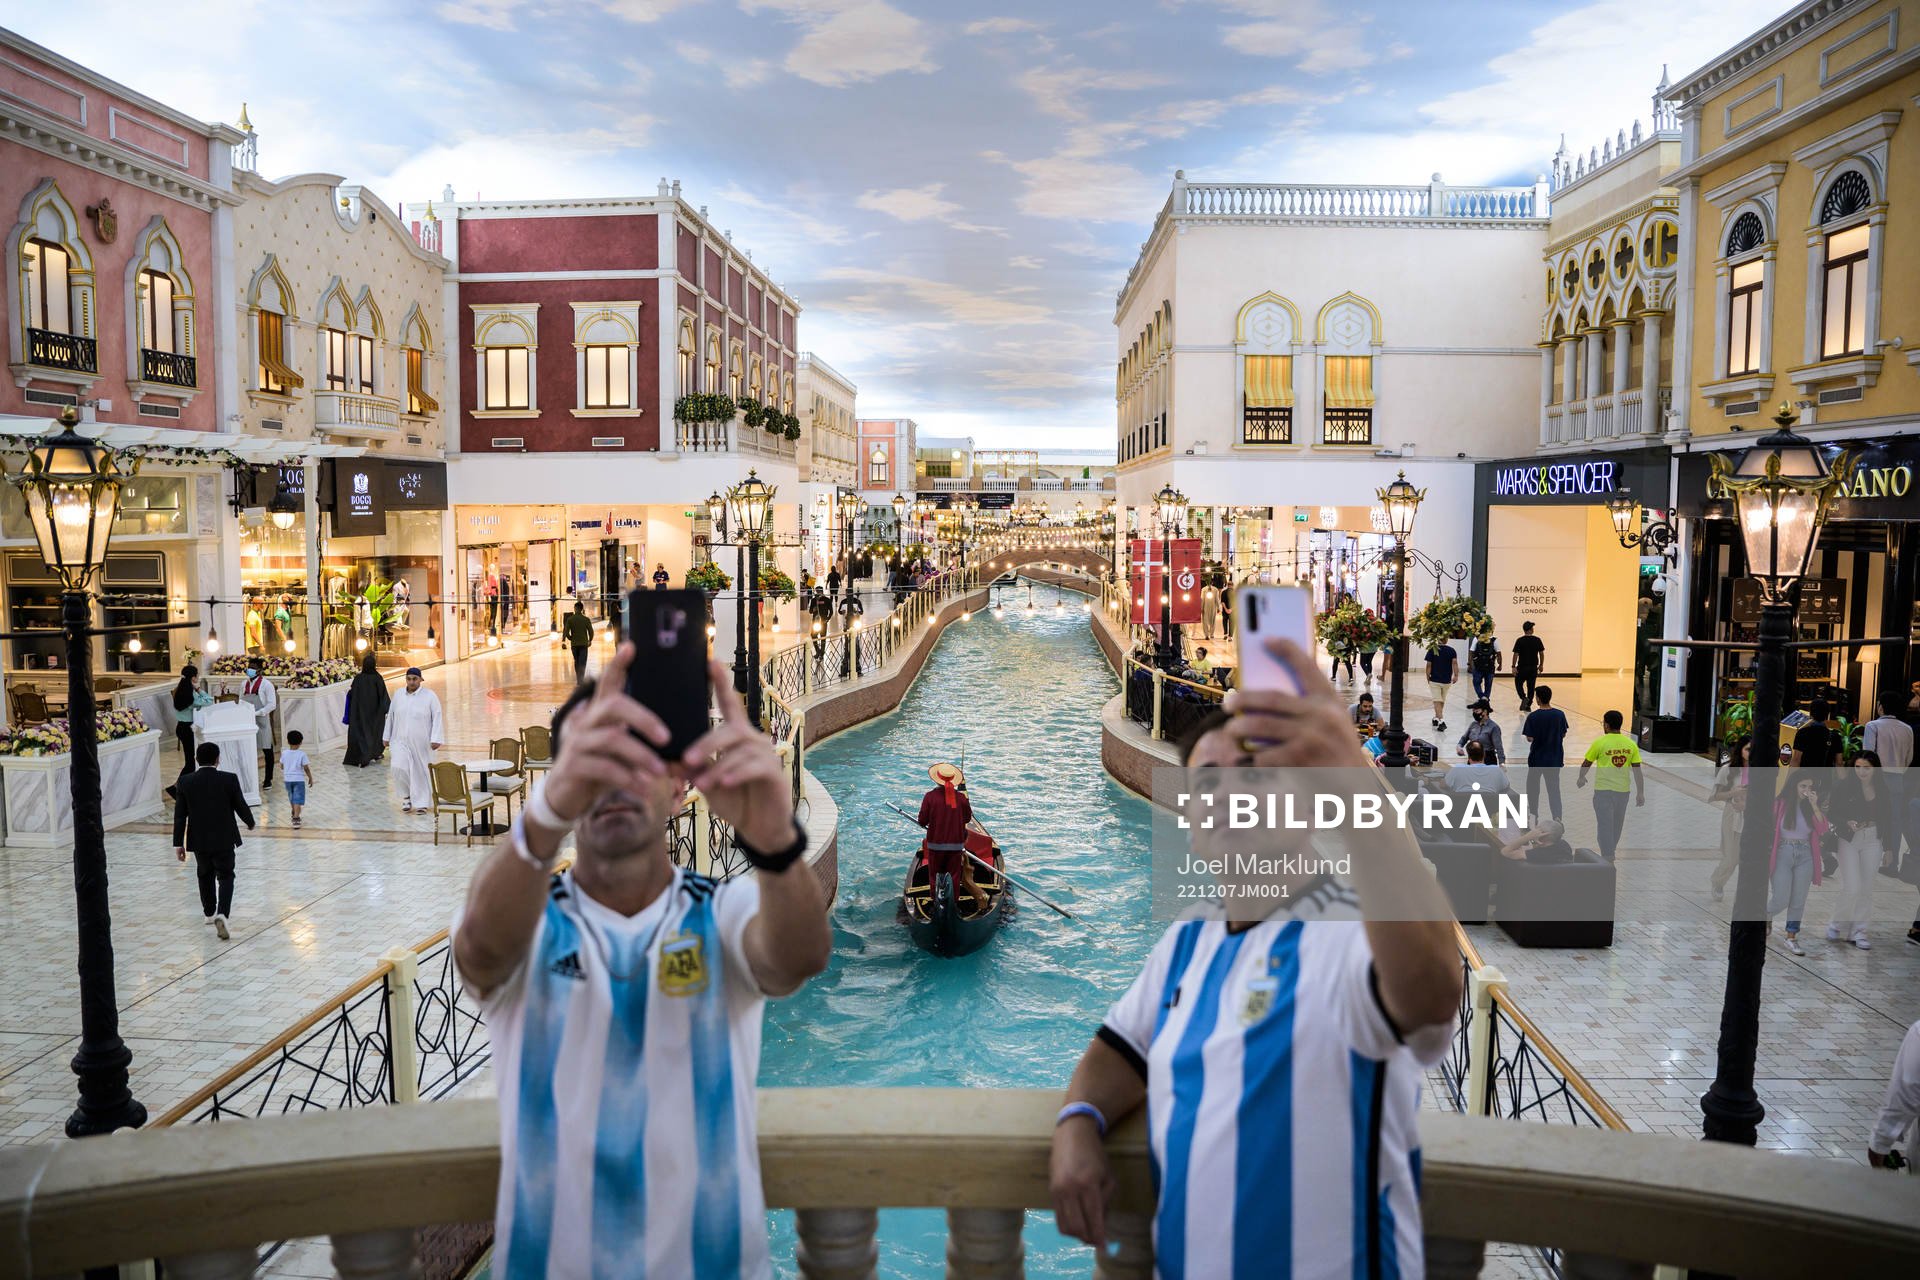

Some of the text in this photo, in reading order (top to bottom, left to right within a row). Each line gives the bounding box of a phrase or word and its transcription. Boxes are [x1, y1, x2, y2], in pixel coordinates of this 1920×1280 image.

[1496, 461, 1613, 495] MARKS&SPENCER
[1514, 585, 1548, 594] MARKS
[1512, 596, 1558, 605] SPENCER
